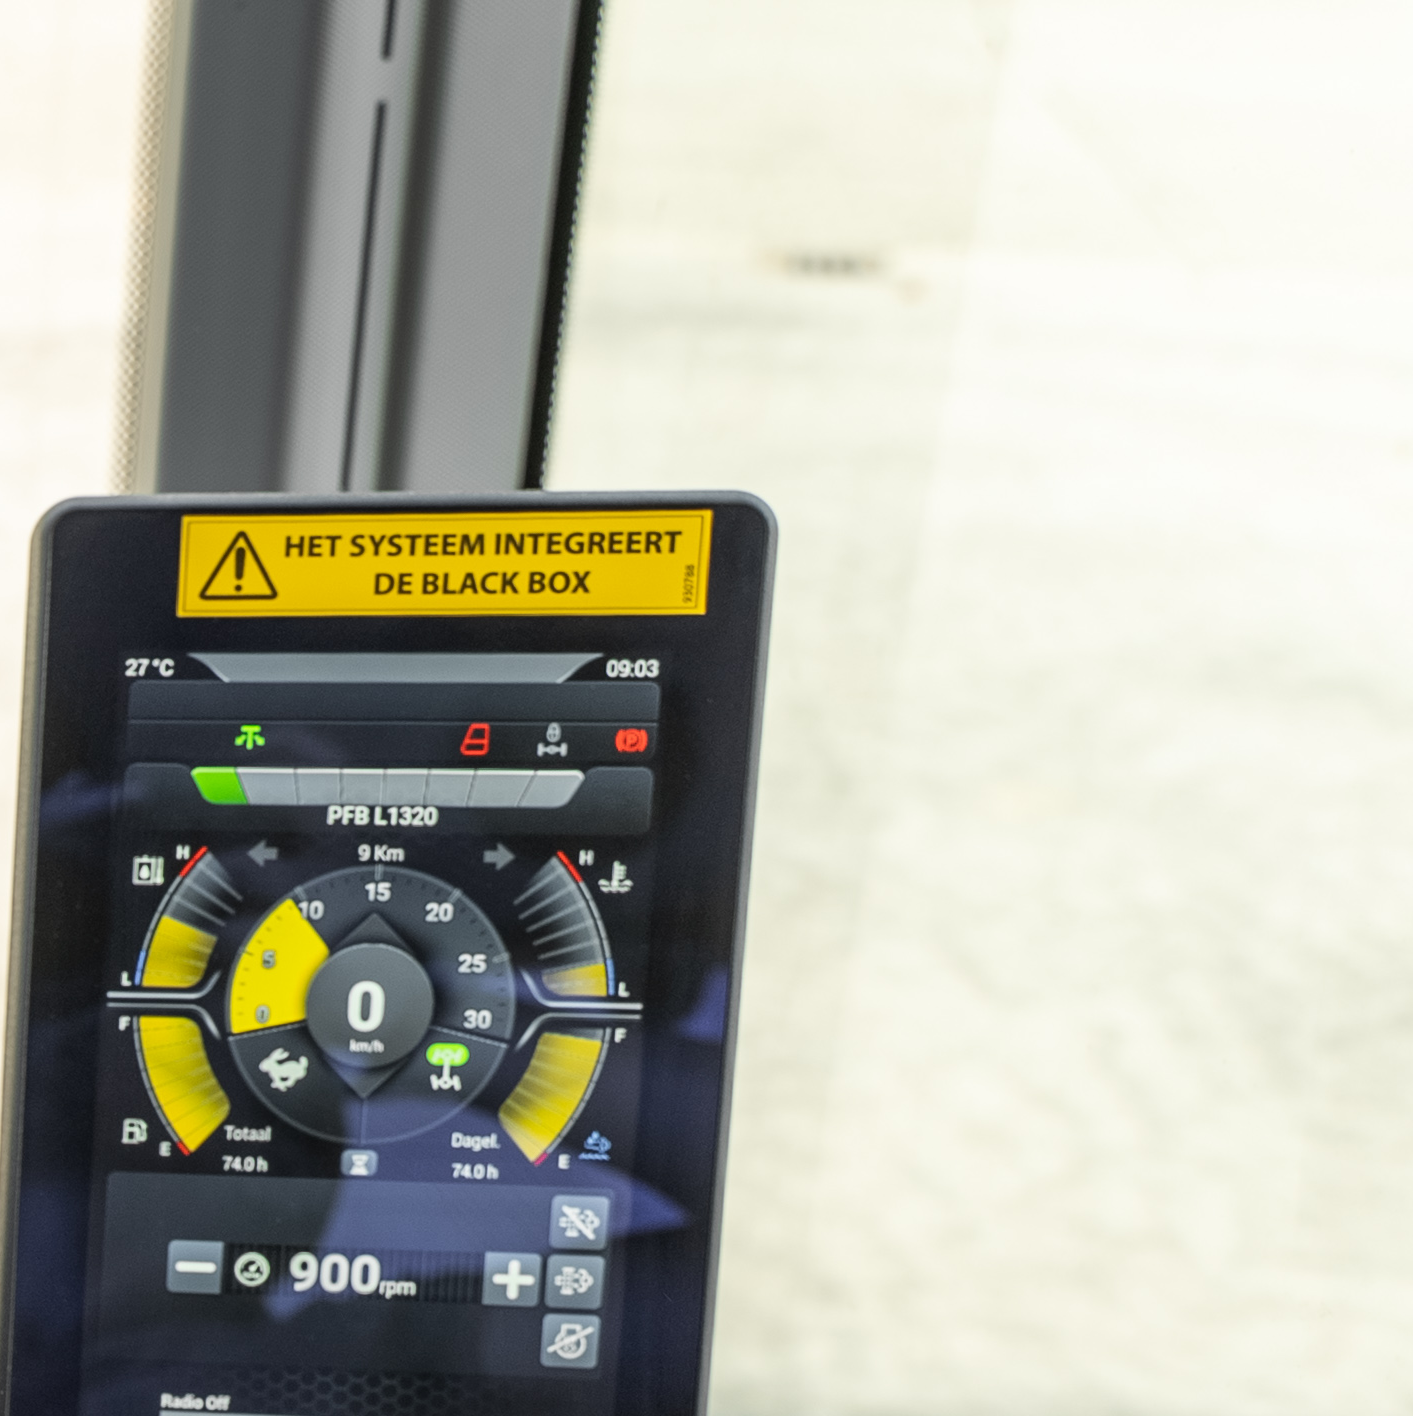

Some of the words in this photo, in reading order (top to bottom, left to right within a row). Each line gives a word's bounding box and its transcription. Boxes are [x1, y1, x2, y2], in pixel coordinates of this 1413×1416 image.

[285, 535, 342, 558] HET
[349, 533, 485, 558] SYSTEEM
[494, 531, 683, 556] INTEGREERT
[374, 572, 413, 595] DE
[422, 571, 520, 595] BLACK
[528, 571, 591, 594] BOX
[605, 659, 660, 678] 09:03
[326, 805, 370, 826] PFB
[373, 805, 439, 827] L1320
[176, 844, 191, 860] H
[358, 844, 372, 862] 9
[373, 845, 405, 863] Km
[579, 849, 594, 866] H
[364, 882, 391, 902] 15
[297, 900, 324, 920] 10
[425, 902, 454, 922] 20
[262, 949, 276, 969] 5
[458, 953, 487, 973] 25
[121, 971, 132, 987] L
[618, 981, 630, 997] L
[347, 980, 385, 1033] 0
[118, 1016, 131, 1031] F
[463, 1009, 492, 1029] 30
[614, 1027, 627, 1043] F
[349, 1039, 384, 1053] km/h
[224, 1125, 272, 1142] Totaal
[159, 1141, 172, 1157] E
[558, 1153, 571, 1170] E
[160, 1393, 204, 1410] Radio
[205, 1395, 231, 1411] Off
